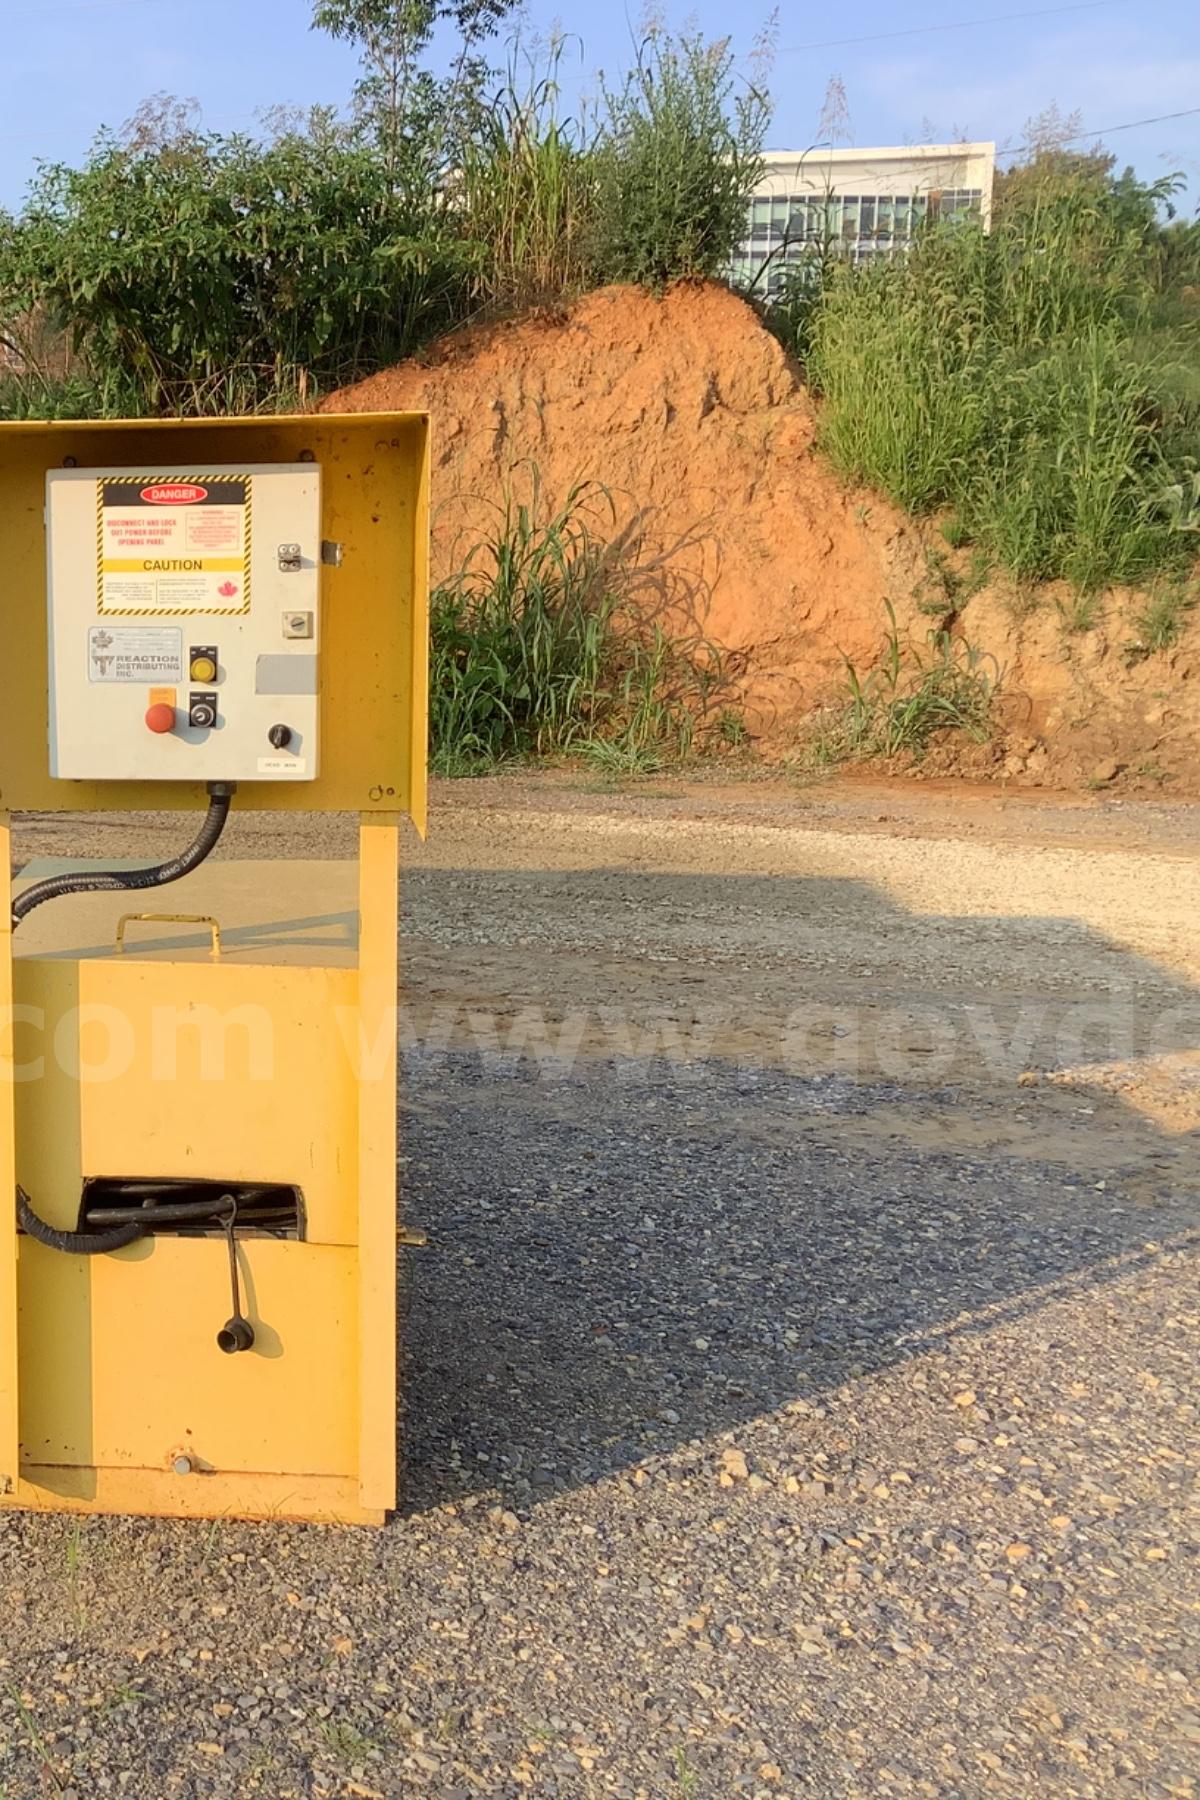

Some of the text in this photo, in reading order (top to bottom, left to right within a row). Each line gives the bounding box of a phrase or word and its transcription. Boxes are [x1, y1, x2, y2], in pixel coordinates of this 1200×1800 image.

[151, 488, 197, 500] DANGER
[143, 559, 203, 571] CAUTION
[116, 655, 179, 663] REACTION
[116, 662, 180, 671] DISTRIBUTING
[116, 670, 134, 678] INC.
